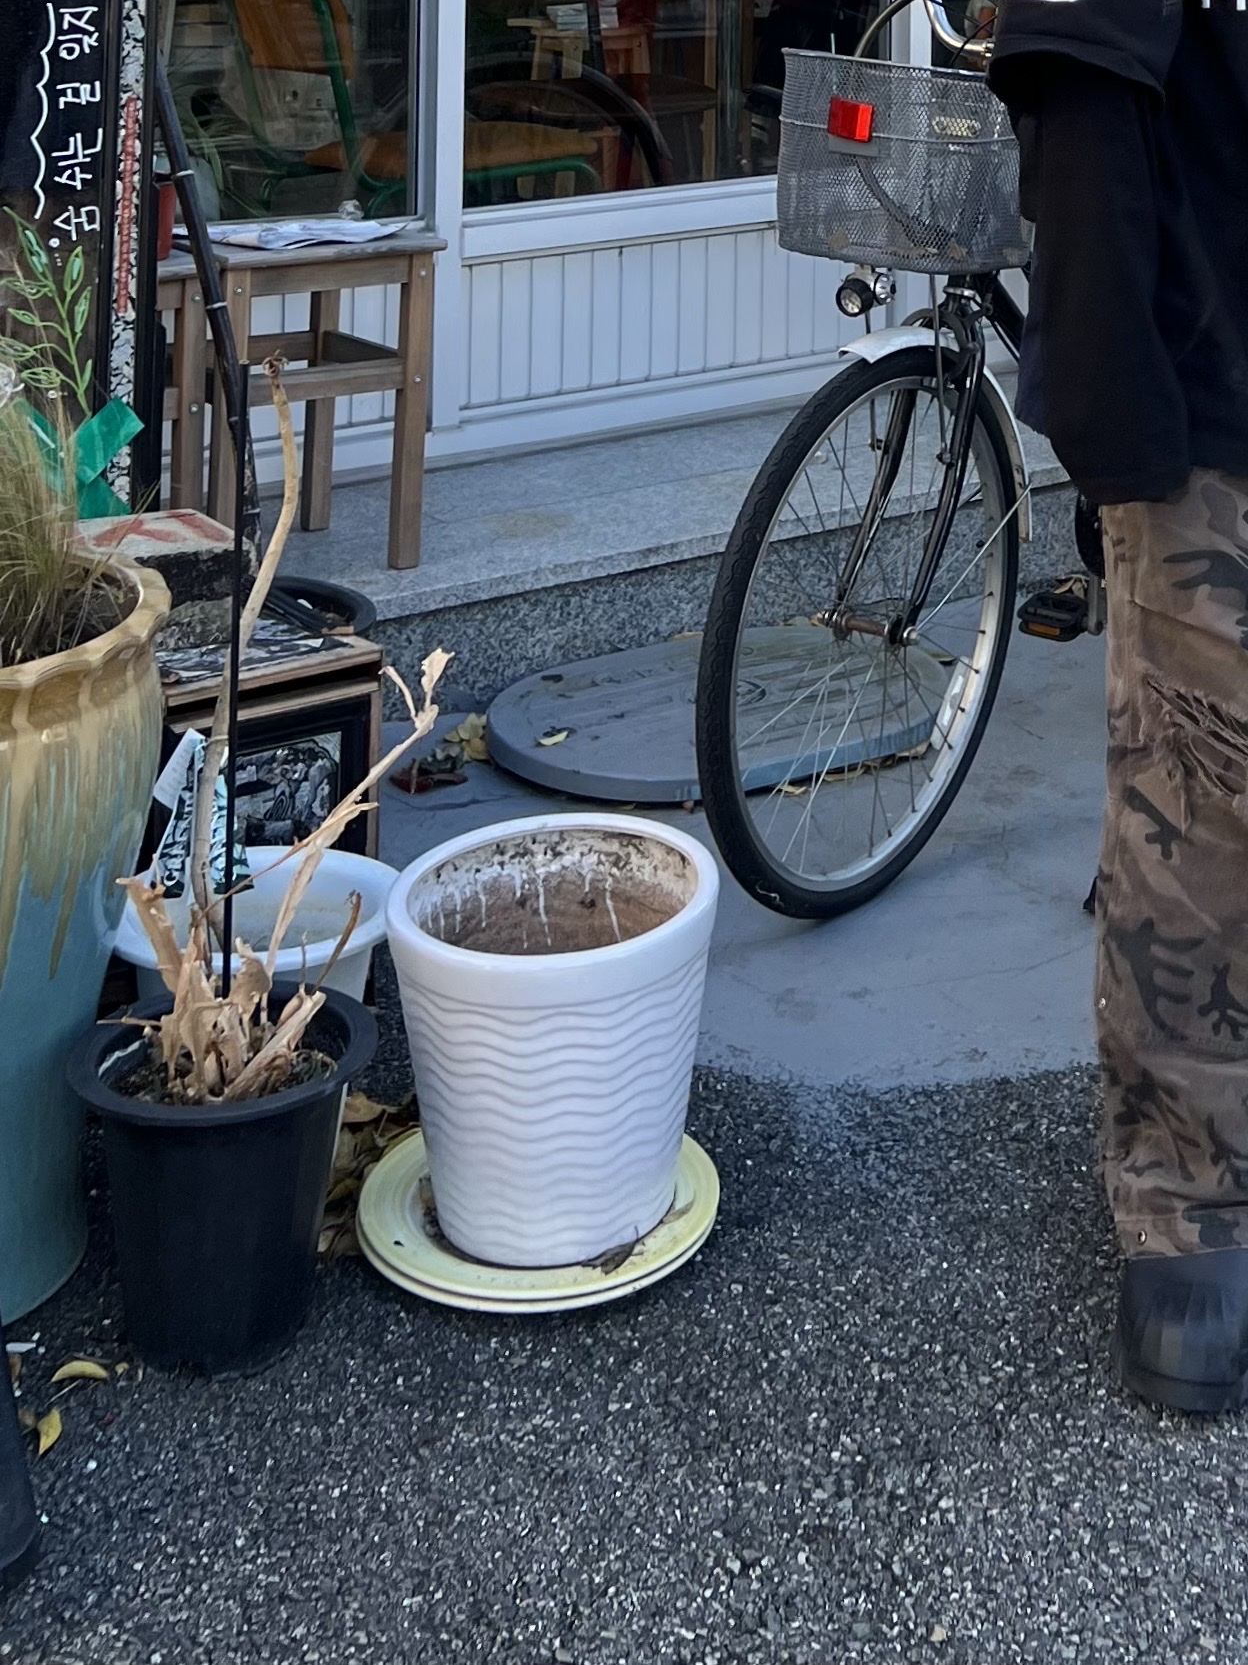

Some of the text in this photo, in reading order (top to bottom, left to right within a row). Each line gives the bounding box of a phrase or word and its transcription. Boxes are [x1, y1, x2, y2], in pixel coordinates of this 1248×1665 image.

[57, 5, 99, 61] 잊지
[55, 80, 102, 110] 걸
[50, 128, 104, 191] 쉬는
[52, 205, 101, 241] 숨
